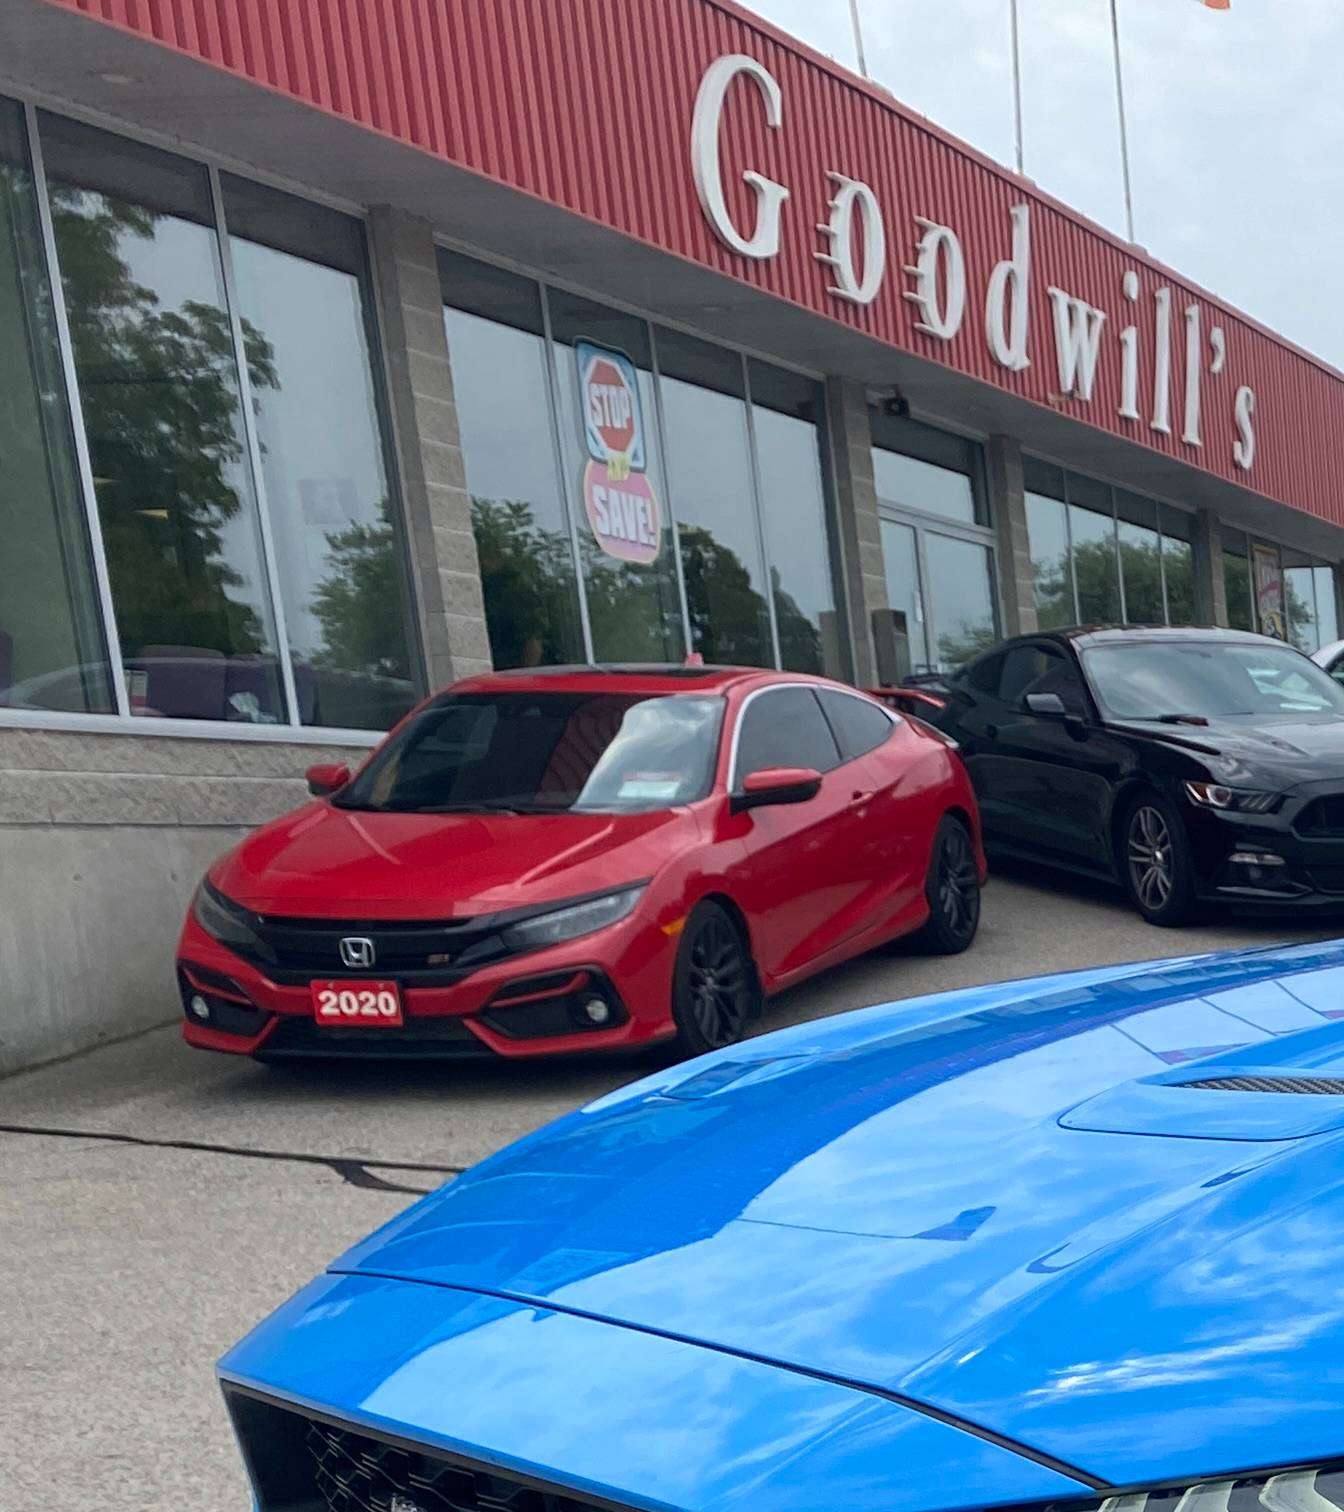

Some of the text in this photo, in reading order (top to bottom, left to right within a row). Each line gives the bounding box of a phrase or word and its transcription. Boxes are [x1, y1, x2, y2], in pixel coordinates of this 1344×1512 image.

[691, 54, 1254, 470] Goodwill's
[588, 383, 632, 429] STOP
[592, 484, 657, 548] SAVE!
[318, 990, 397, 1017] 2020
